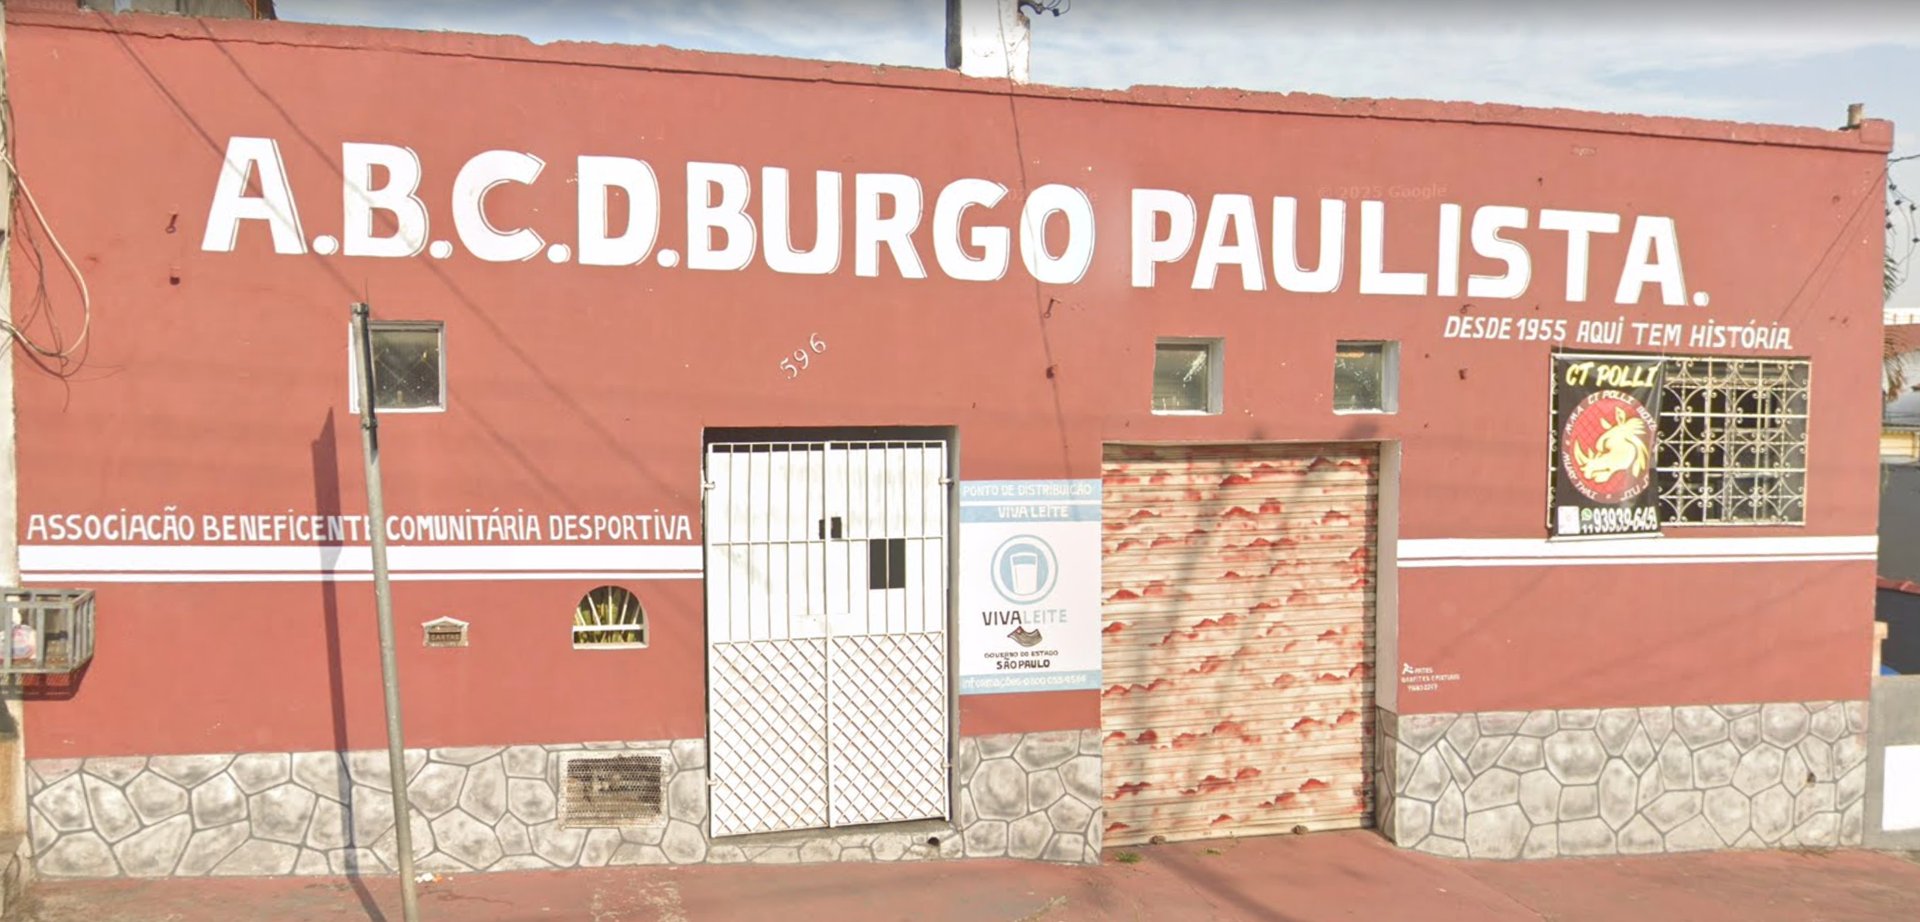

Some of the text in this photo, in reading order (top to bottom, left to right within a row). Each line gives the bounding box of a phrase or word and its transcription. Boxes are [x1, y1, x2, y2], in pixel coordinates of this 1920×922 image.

[1132, 189, 1710, 307] PAULISTA.
[1444, 316, 1512, 340] DESDE
[1516, 318, 1567, 342] 1955
[1576, 316, 1625, 345] AQUI
[1632, 323, 1682, 347] TEM
[779, 332, 827, 380] 596
[1565, 361, 1661, 388] CT POLLI
[1602, 390, 1635, 405] POLLI
[962, 485, 998, 497] PONTO
[1002, 485, 1015, 495] DE
[386, 507, 541, 541] COMUNITÁRIA
[549, 508, 692, 541] DESPORTIVA
[984, 651, 1019, 659] GOVERNO
[996, 657, 1051, 669] SÃO PAULO
